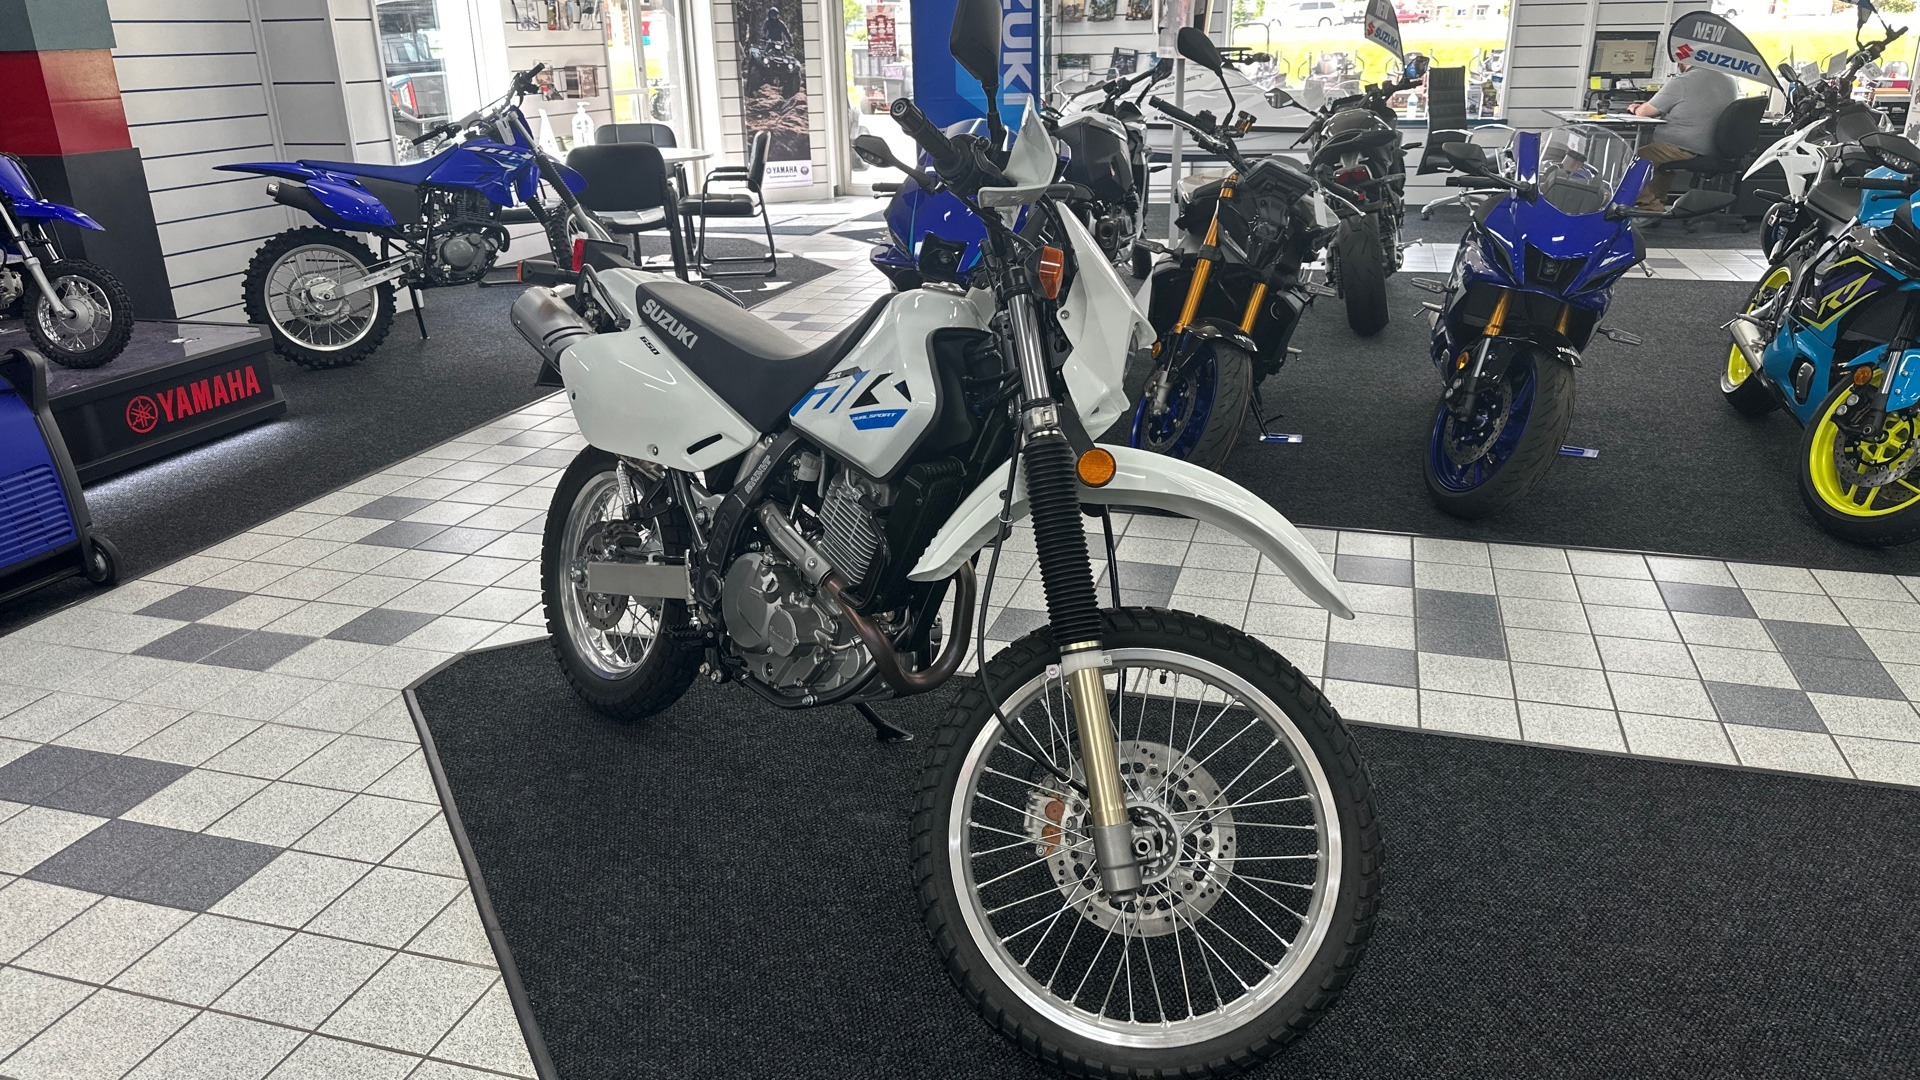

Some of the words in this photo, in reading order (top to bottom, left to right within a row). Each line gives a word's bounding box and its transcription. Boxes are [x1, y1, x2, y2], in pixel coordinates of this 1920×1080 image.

[1374, 27, 1399, 50] SUZUKI
[1692, 21, 1727, 43] NEW
[1002, 0, 1032, 105] UKI
[1694, 49, 1761, 76] SUZUKI
[772, 166, 798, 174] YAMAHA
[1817, 271, 1873, 319] R7
[641, 299, 699, 350] SUZUKI
[639, 336, 661, 355] 650
[157, 365, 261, 423] YAMAHA
